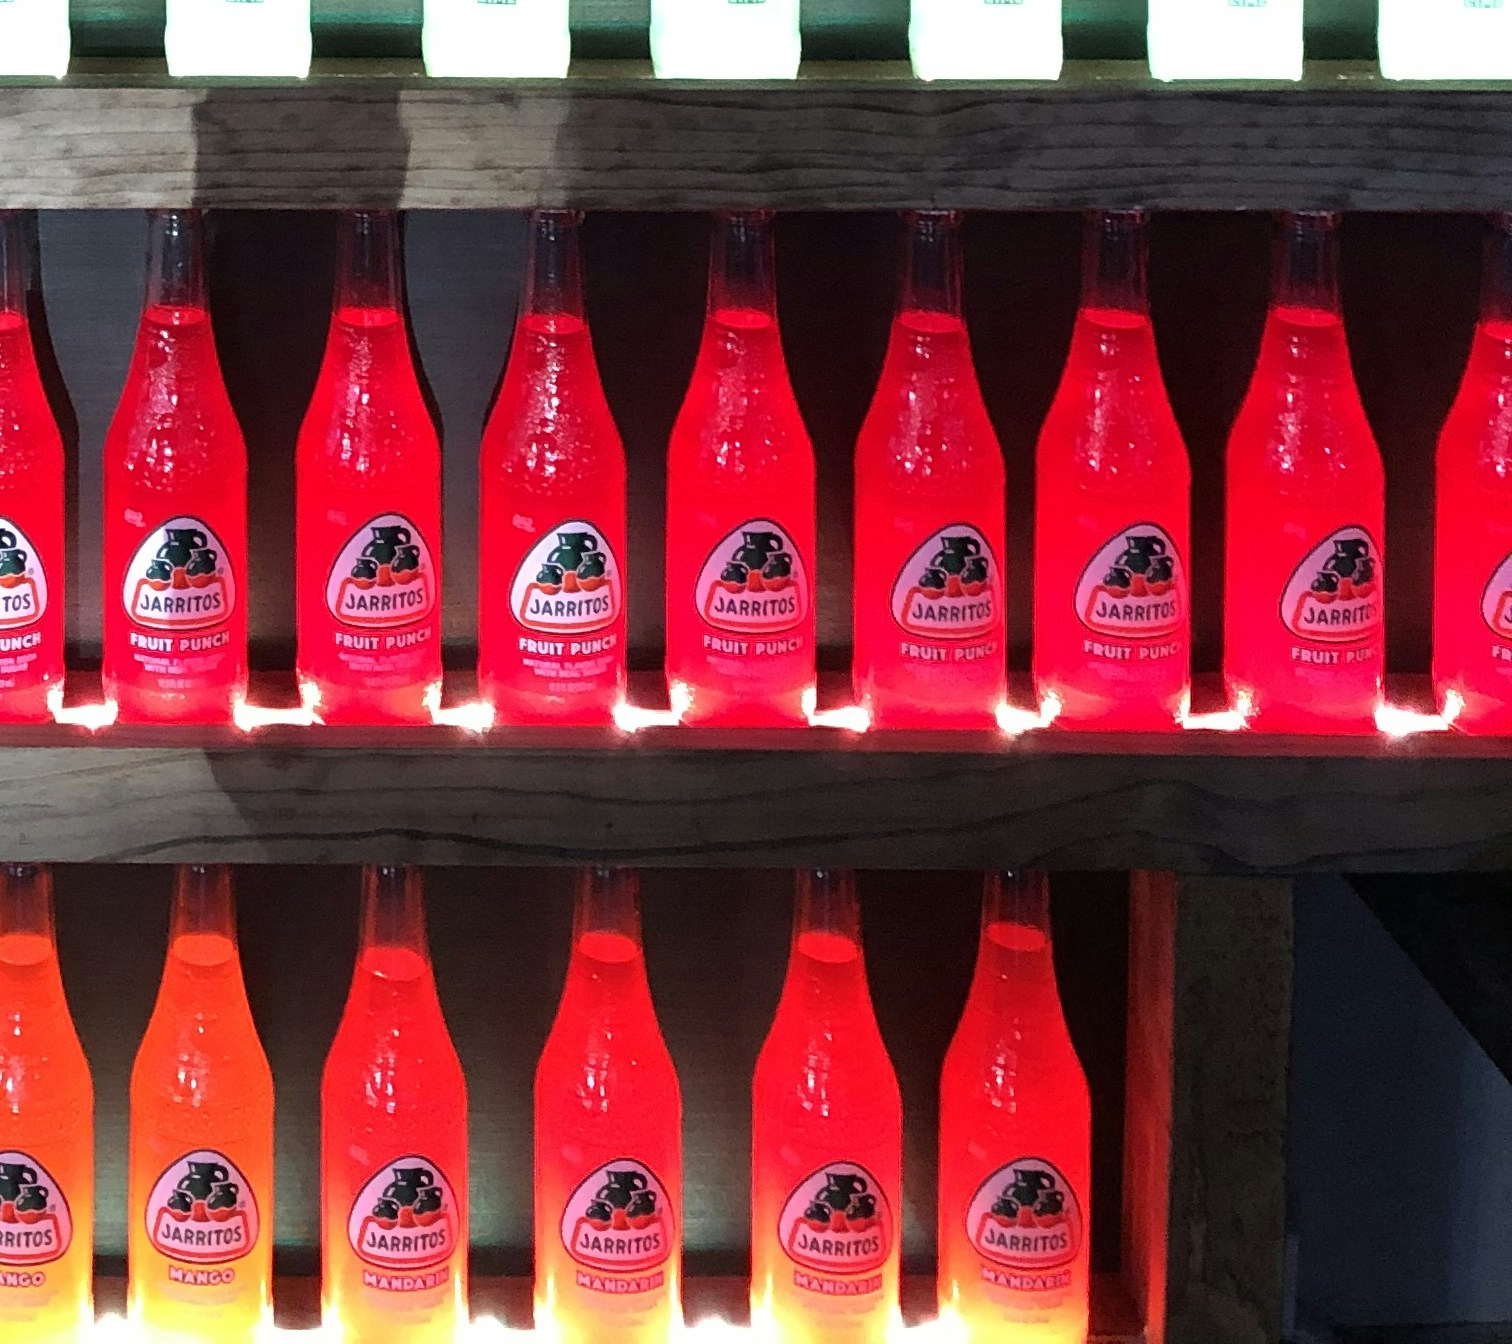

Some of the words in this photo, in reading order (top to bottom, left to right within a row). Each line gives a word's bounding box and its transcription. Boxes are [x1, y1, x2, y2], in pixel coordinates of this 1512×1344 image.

[140, 593, 221, 613] JARRITOS
[344, 590, 424, 612] JARRITOS
[529, 594, 609, 616] JARRITOS
[714, 596, 795, 616] JARRITOS
[911, 601, 991, 622] JARRITOS
[1096, 600, 1176, 619] JARRITOS
[130, 632, 173, 652] FRUIT
[179, 631, 230, 652] PUNCH
[335, 631, 379, 651] FRUIT
[384, 629, 432, 650] PUNCH
[519, 637, 564, 656] FRUIT
[703, 634, 750, 655] FRUIT
[900, 642, 947, 662] FRUIT
[1291, 646, 1339, 665] FRUIT
[161, 1223, 242, 1245] JARRITOS
[366, 1231, 446, 1253] JARRITOS
[580, 1232, 660, 1255] JARRITOS
[984, 1228, 1068, 1251] JARRITOS
[797, 1234, 879, 1257] JARRITOS
[168, 1265, 235, 1285] MANGO
[362, 1268, 450, 1291] MANDARIN
[576, 1270, 664, 1293] MANDARIN
[793, 1273, 882, 1295] MANDARIN
[980, 1266, 1072, 1291] MANDARIN
